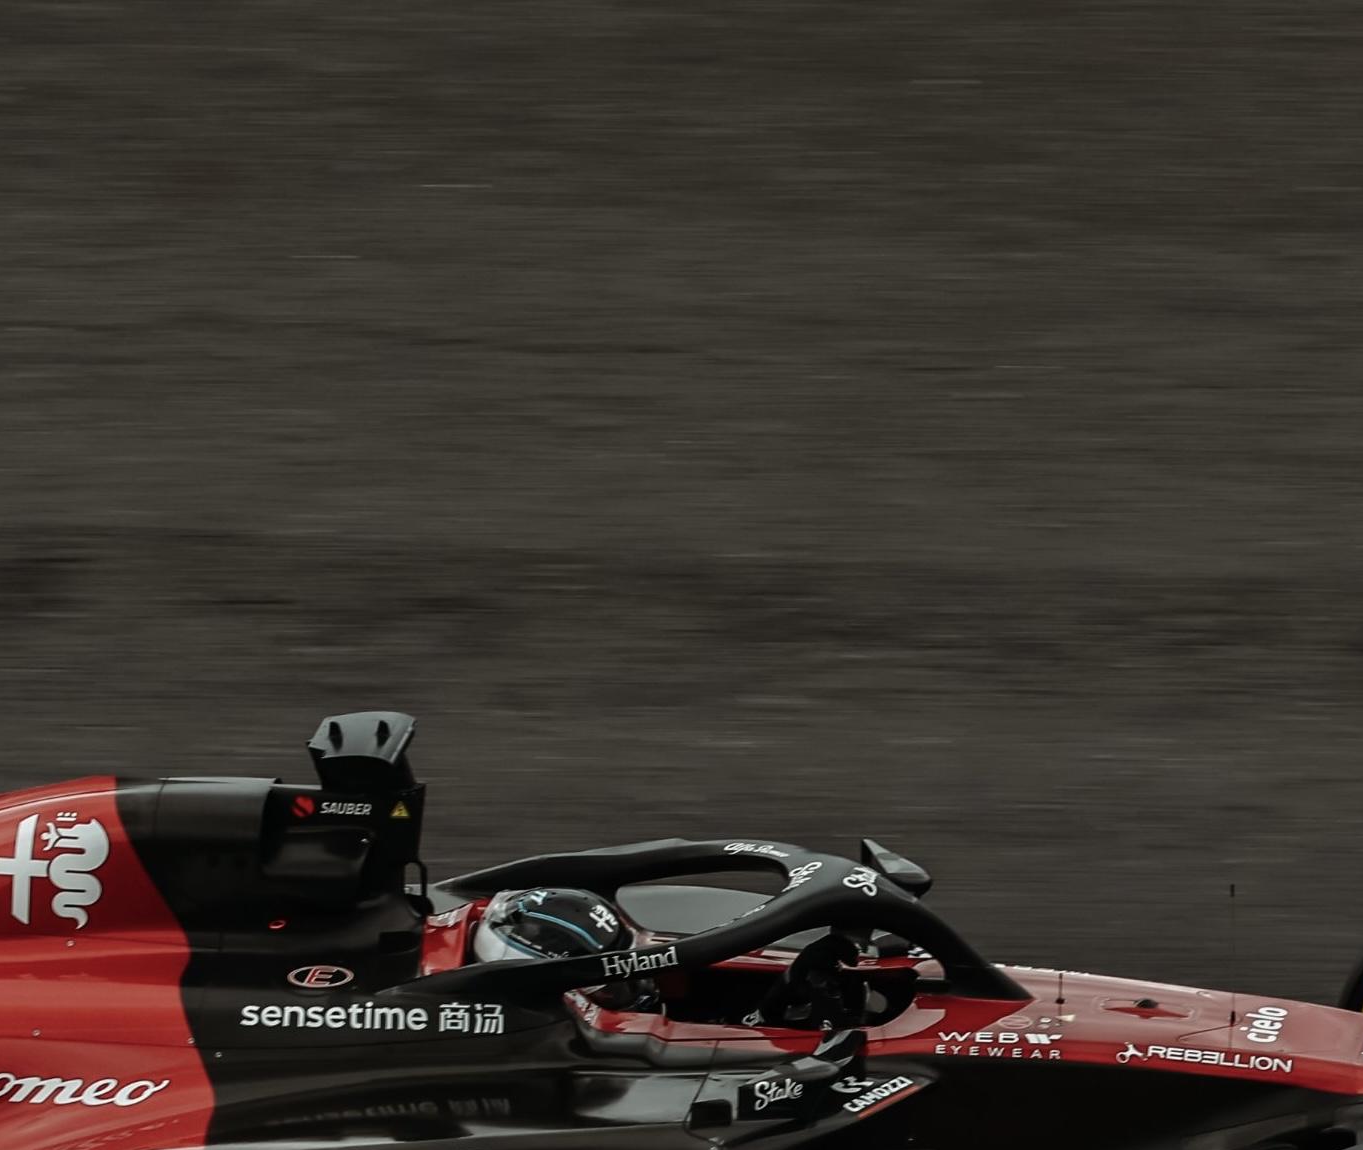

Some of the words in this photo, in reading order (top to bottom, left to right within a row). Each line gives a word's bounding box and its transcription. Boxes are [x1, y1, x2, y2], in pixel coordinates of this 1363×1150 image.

[320, 802, 372, 815] SAUBER
[600, 947, 679, 978] Hyland
[240, 1002, 429, 1030] sensetime
[439, 1002, 504, 1034] 商汤
[1240, 1007, 1288, 1043] cielo
[935, 1045, 1061, 1060] EYEWEAR
[938, 1031, 1020, 1044] WEB
[1147, 1045, 1293, 1073] REBELLION
[754, 1078, 803, 1111] Stake
[843, 1076, 914, 1112] CAMOZZI
